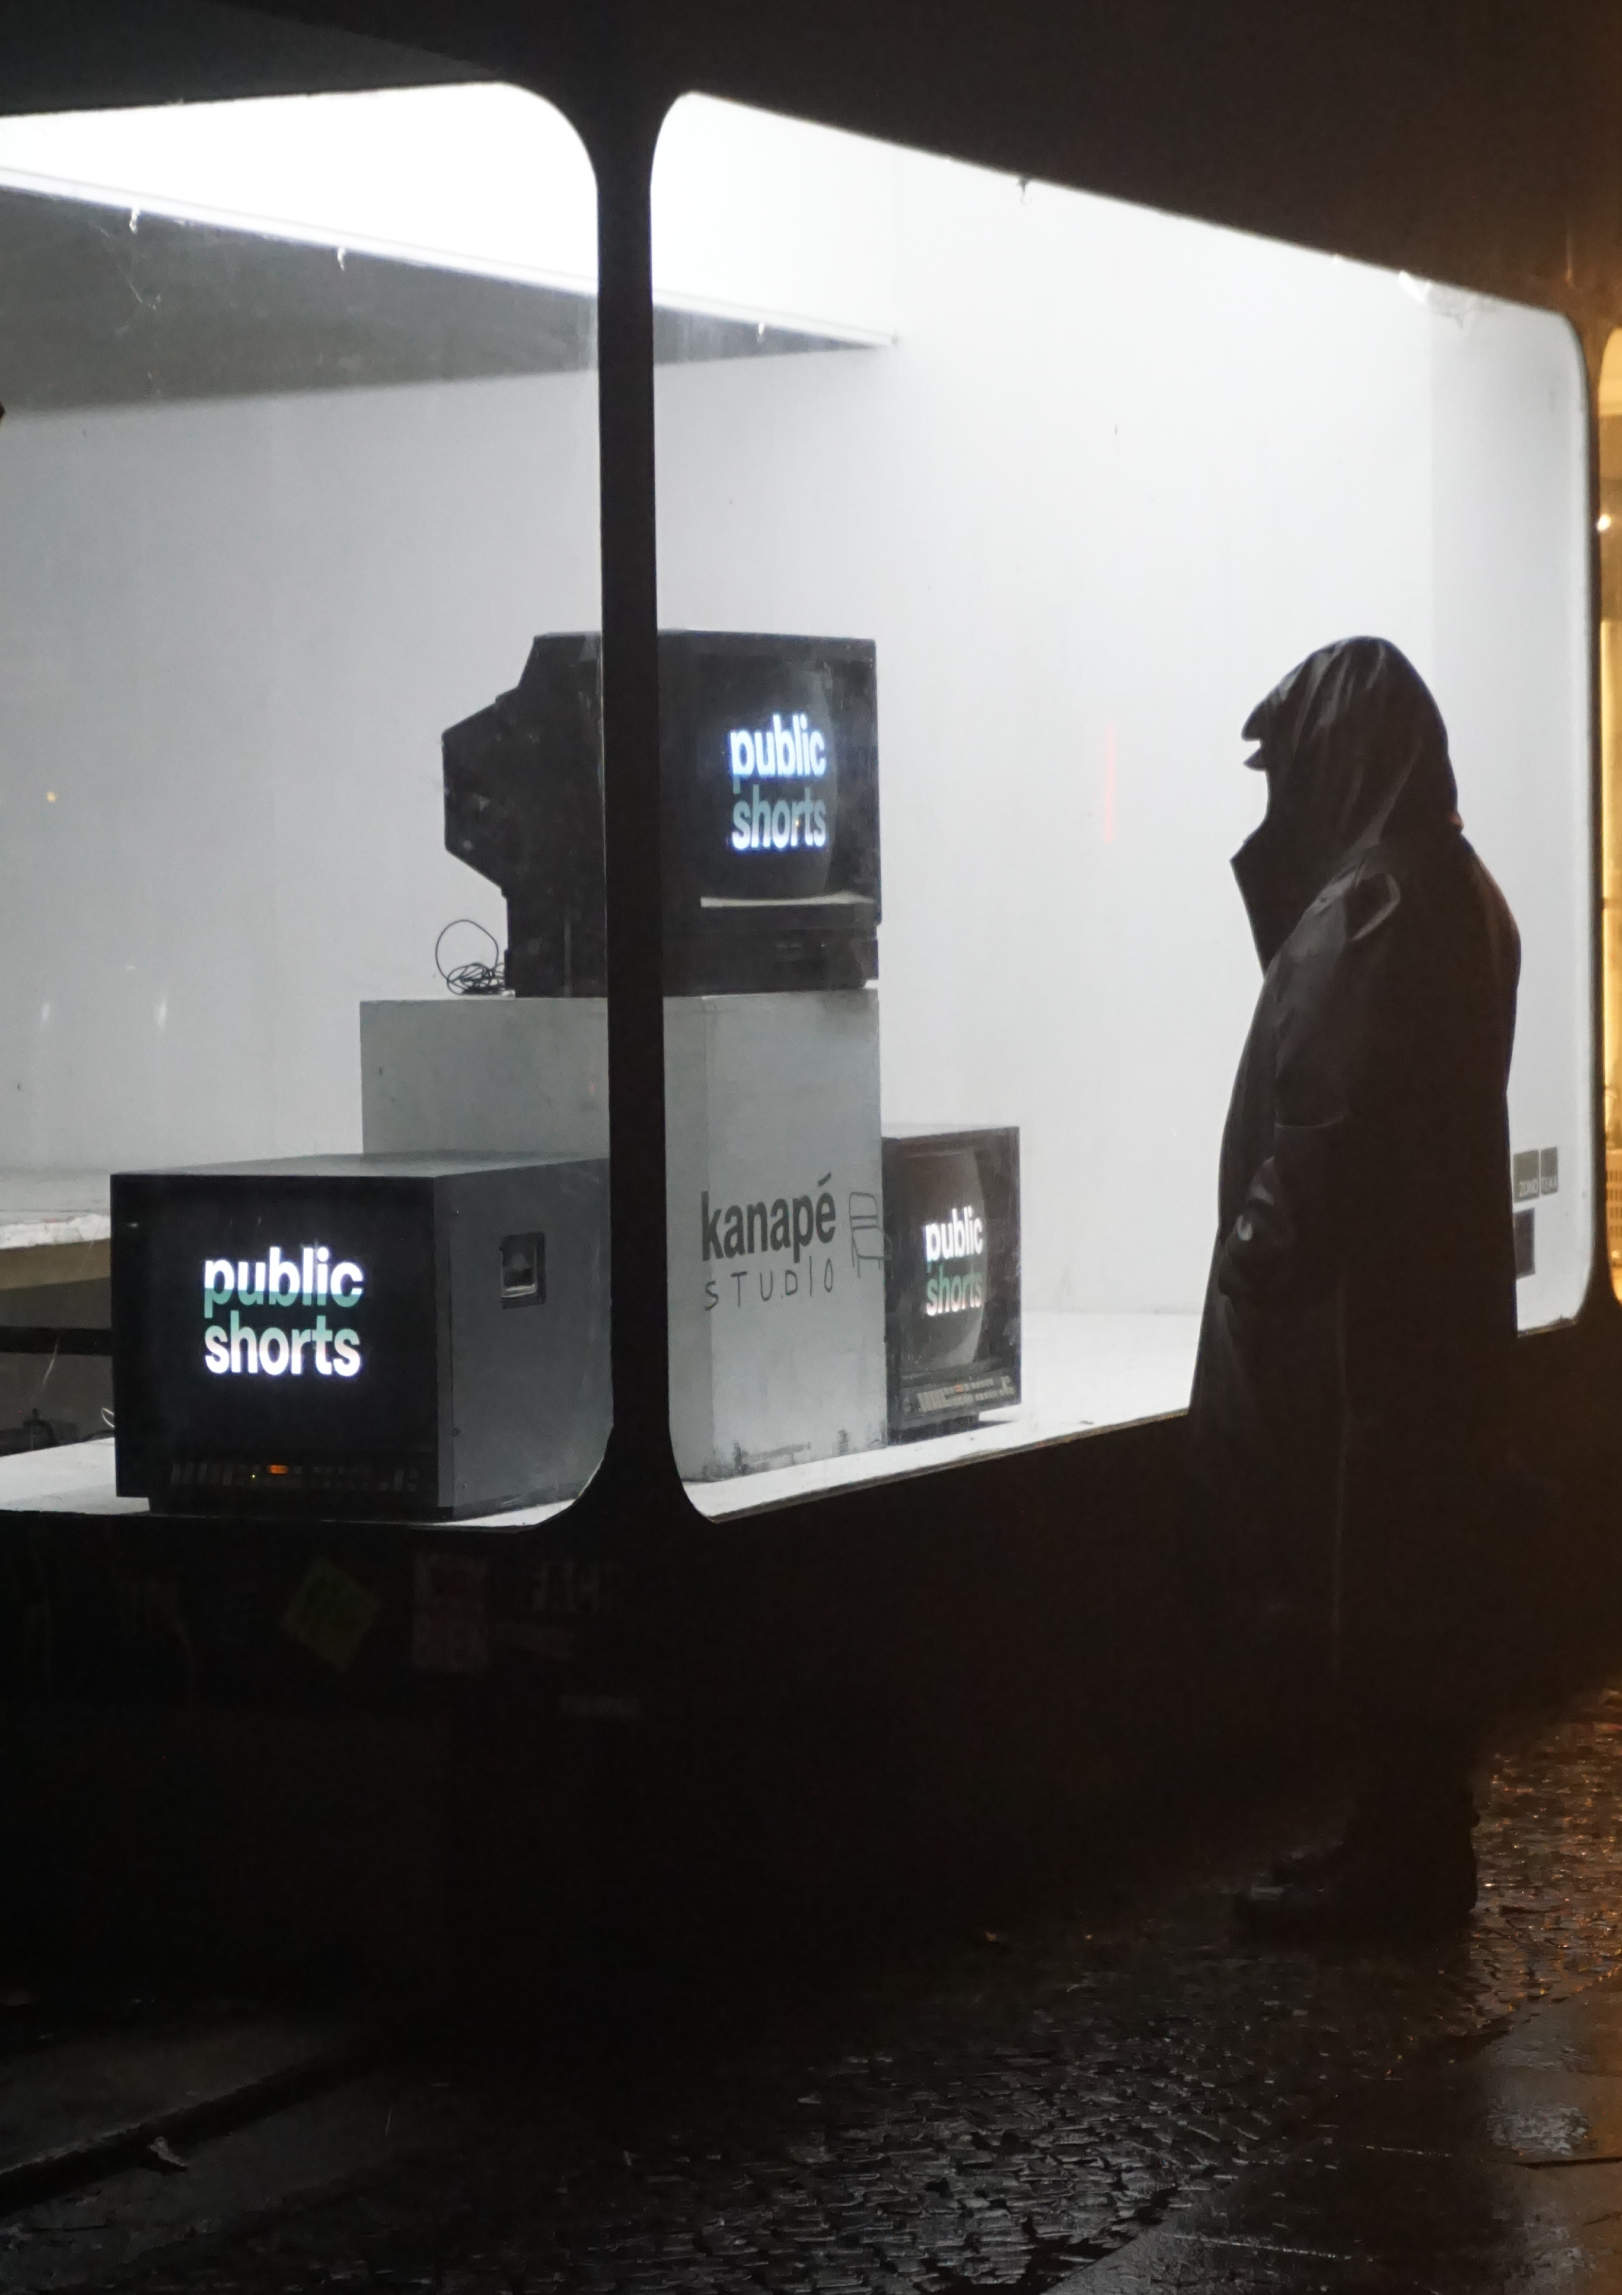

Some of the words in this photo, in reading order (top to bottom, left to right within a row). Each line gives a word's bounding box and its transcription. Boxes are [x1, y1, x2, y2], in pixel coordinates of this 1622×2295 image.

[729, 713, 827, 794] public
[731, 783, 827, 850] shorts
[701, 1172, 836, 1263] kanapé
[924, 1205, 983, 1272] public
[204, 1246, 364, 1318] public
[704, 1255, 834, 1311] STUDIO
[926, 1264, 983, 1317] shorts
[204, 1310, 362, 1377] shorts
